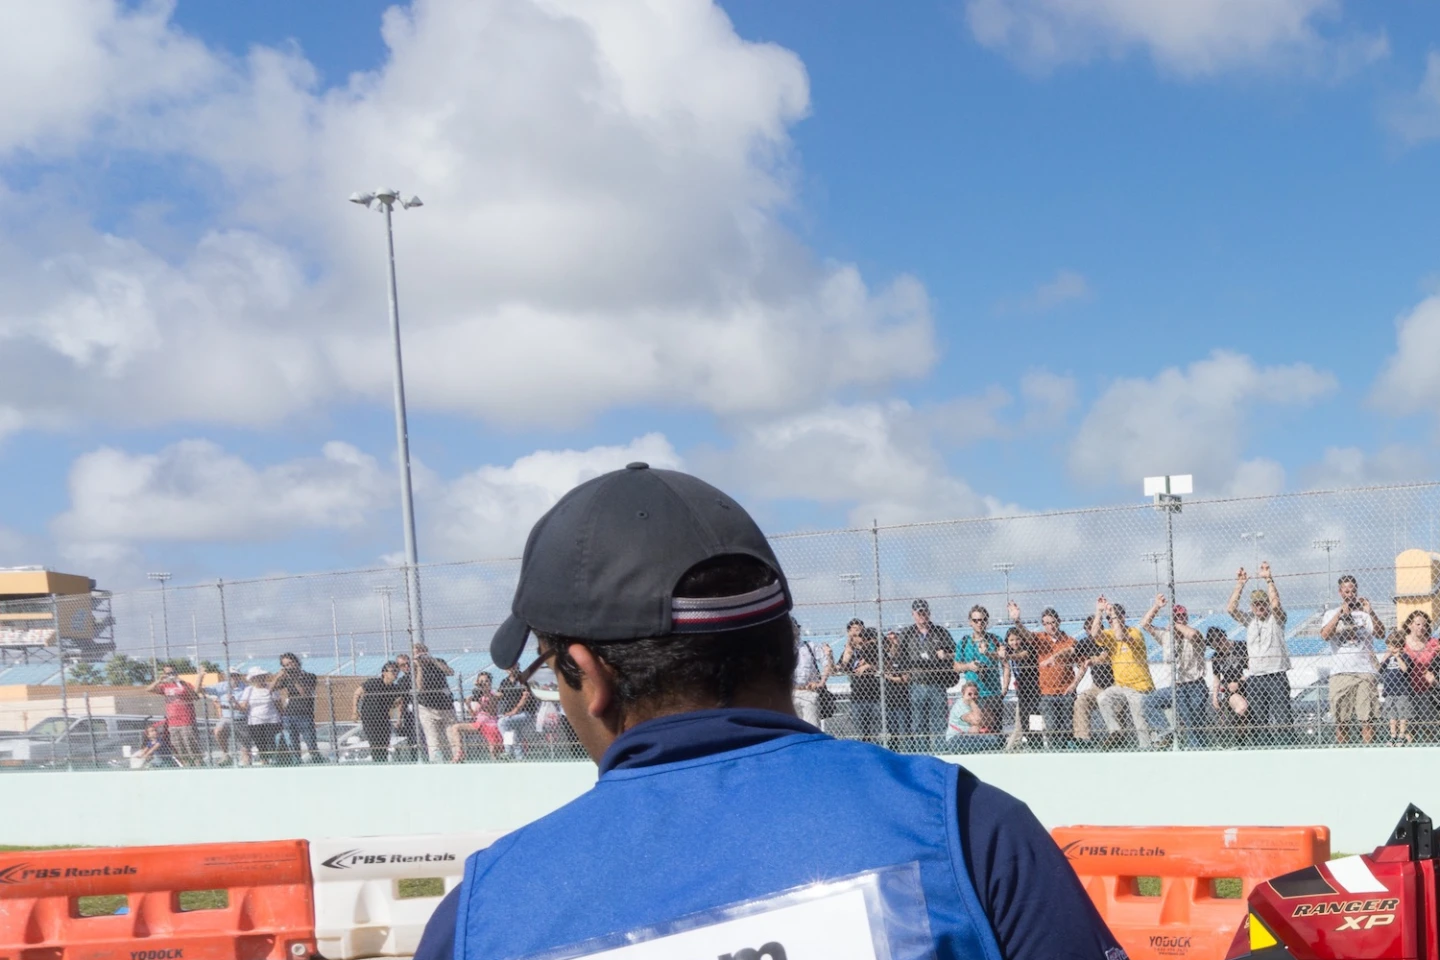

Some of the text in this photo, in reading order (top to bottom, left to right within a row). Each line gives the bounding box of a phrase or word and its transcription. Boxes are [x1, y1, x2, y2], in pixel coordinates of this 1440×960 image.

[1080, 846, 1166, 856] PBS Rentals
[352, 853, 456, 865] PBS Rentals
[22, 865, 138, 879] PBS Rentals
[1292, 898, 1400, 917] RANGER
[1335, 914, 1395, 931] XP
[1149, 936, 1191, 948] YODOCK
[130, 949, 183, 960] YODOCK
